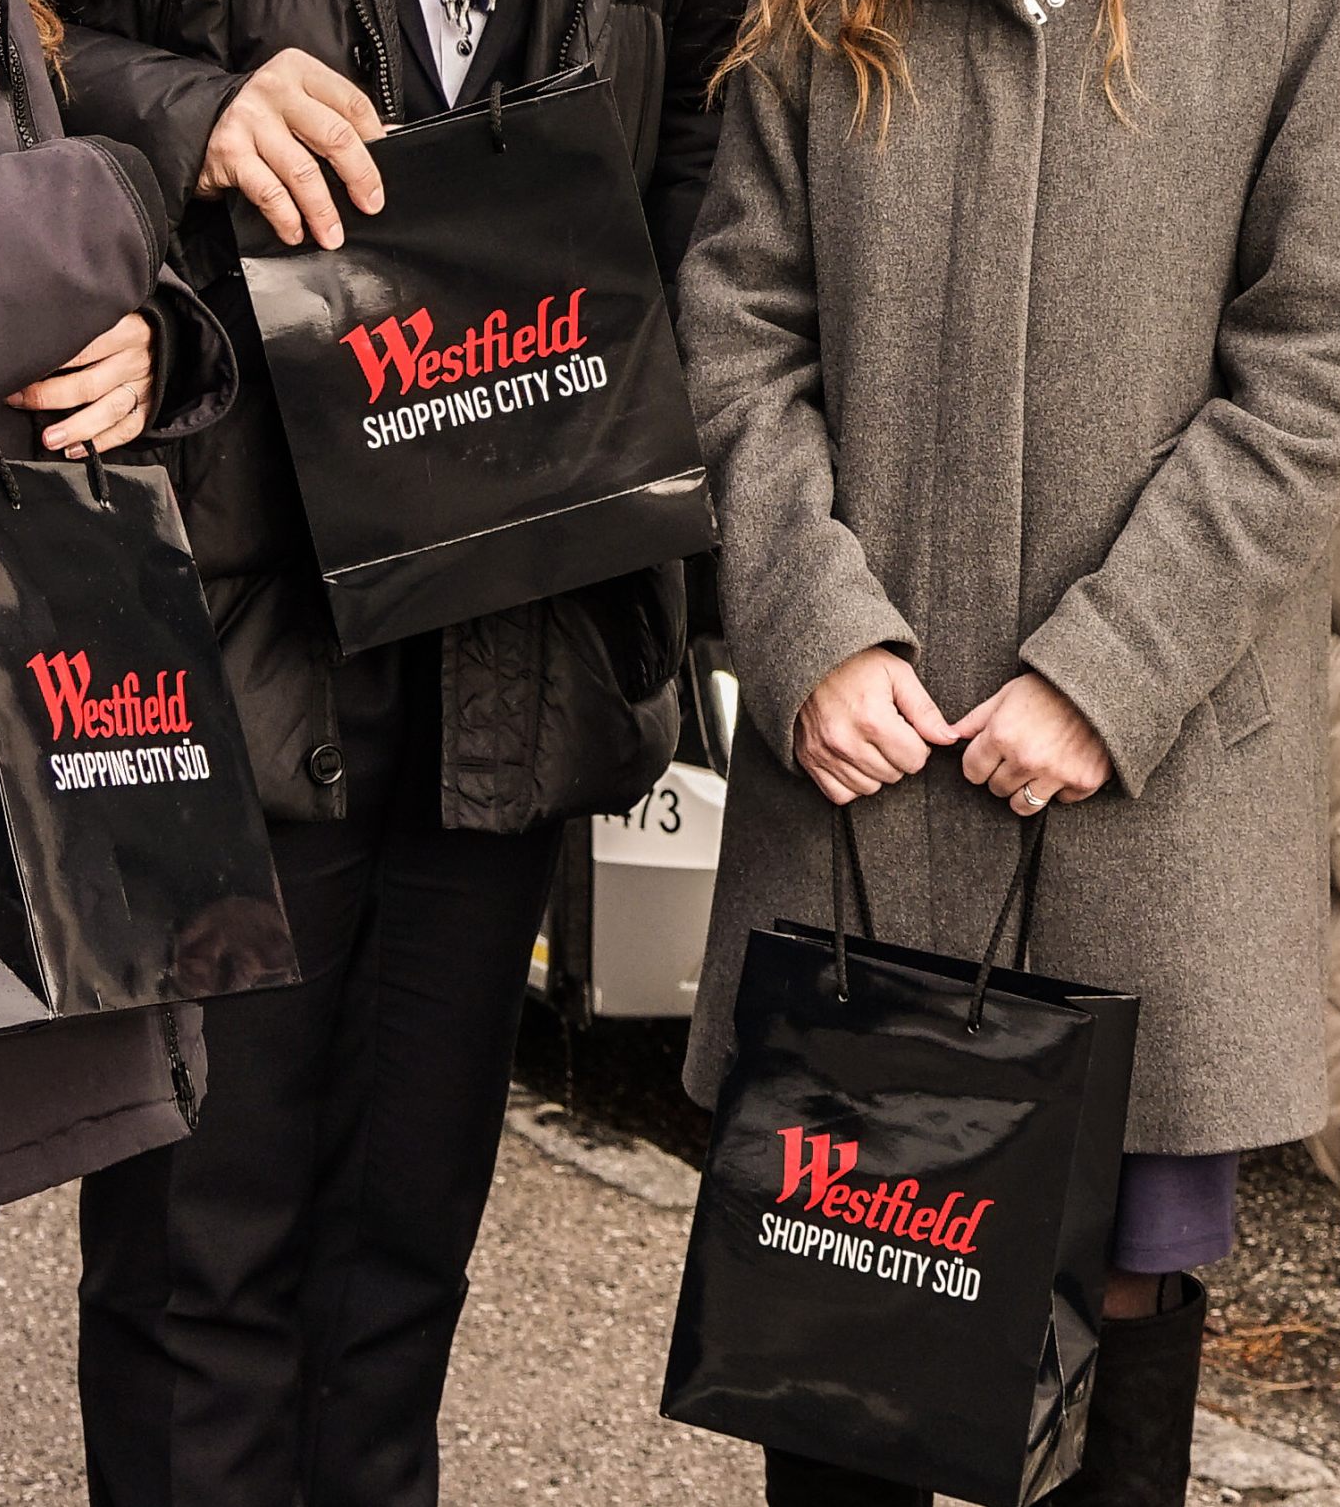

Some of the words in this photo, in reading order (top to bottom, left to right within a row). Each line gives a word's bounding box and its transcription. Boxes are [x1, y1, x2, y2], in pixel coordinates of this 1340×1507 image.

[338, 287, 589, 405] Westfield
[362, 385, 493, 451] SHOPPING
[494, 368, 550, 414] CITY
[554, 353, 609, 397] SÜD
[26, 650, 194, 742] Westfield
[50, 748, 139, 791] SHOPPING
[135, 745, 175, 783] CITY
[174, 737, 211, 781] SÜD
[775, 1125, 995, 1255] Westfield
[758, 1212, 874, 1273] SHOPPING
[876, 1244, 931, 1289] CITY
[931, 1256, 982, 1302] SÜD
